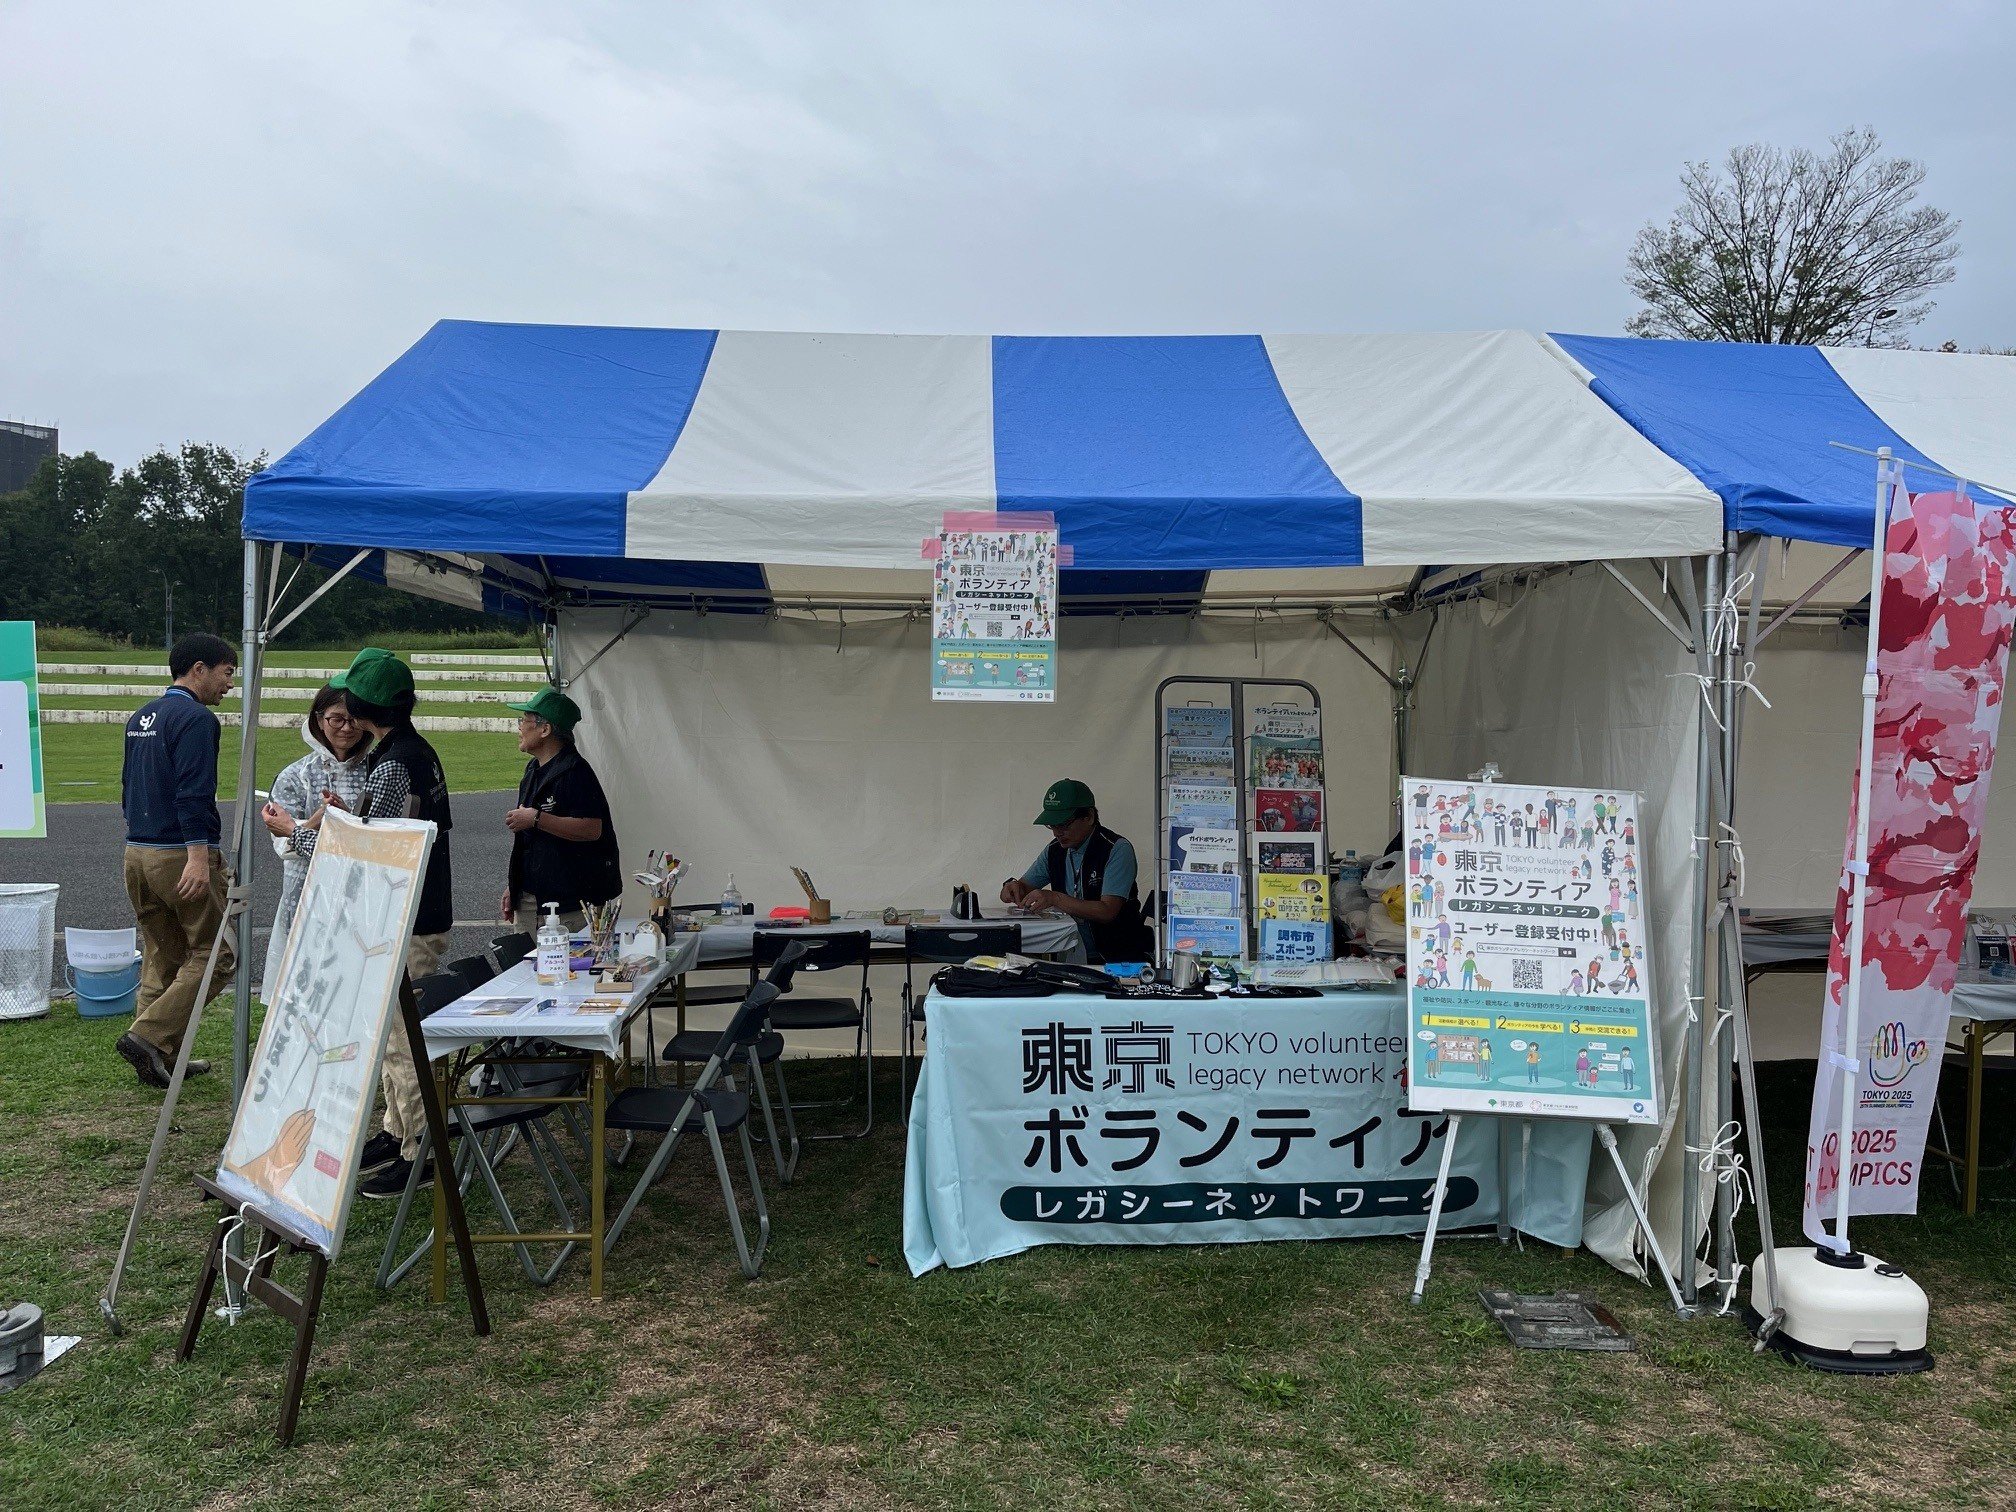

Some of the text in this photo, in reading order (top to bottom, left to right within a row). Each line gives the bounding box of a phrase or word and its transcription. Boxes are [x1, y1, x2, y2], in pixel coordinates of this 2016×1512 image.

[960, 564, 985, 576] 東京
[959, 578, 1031, 590] ボランティア
[958, 603, 1032, 611] ユーザー登録受付中!
[1454, 849, 1503, 873] 東京
[1506, 855, 1576, 866] TOKYO volunteer
[1506, 864, 1531, 874] legacy
[1454, 876, 1591, 901] ボランティア
[1457, 901, 1591, 917] レガシーネットワーク
[1278, 930, 1315, 942] 調布市
[1453, 921, 1598, 943] ユーザー登録受付中!
[1276, 943, 1316, 956] スポーツ
[1497, 1015, 1507, 1030] 2
[1571, 1019, 1580, 1034] 3
[1187, 1032, 1278, 1054] TOKYO
[1022, 1021, 1176, 1094] 東京
[1187, 1062, 1384, 1091] legacy network
[1862, 1091, 1912, 1099] TOKYO 2025
[1500, 1100, 1523, 1108] 東京都
[1024, 1105, 1450, 1173] ボランティア
